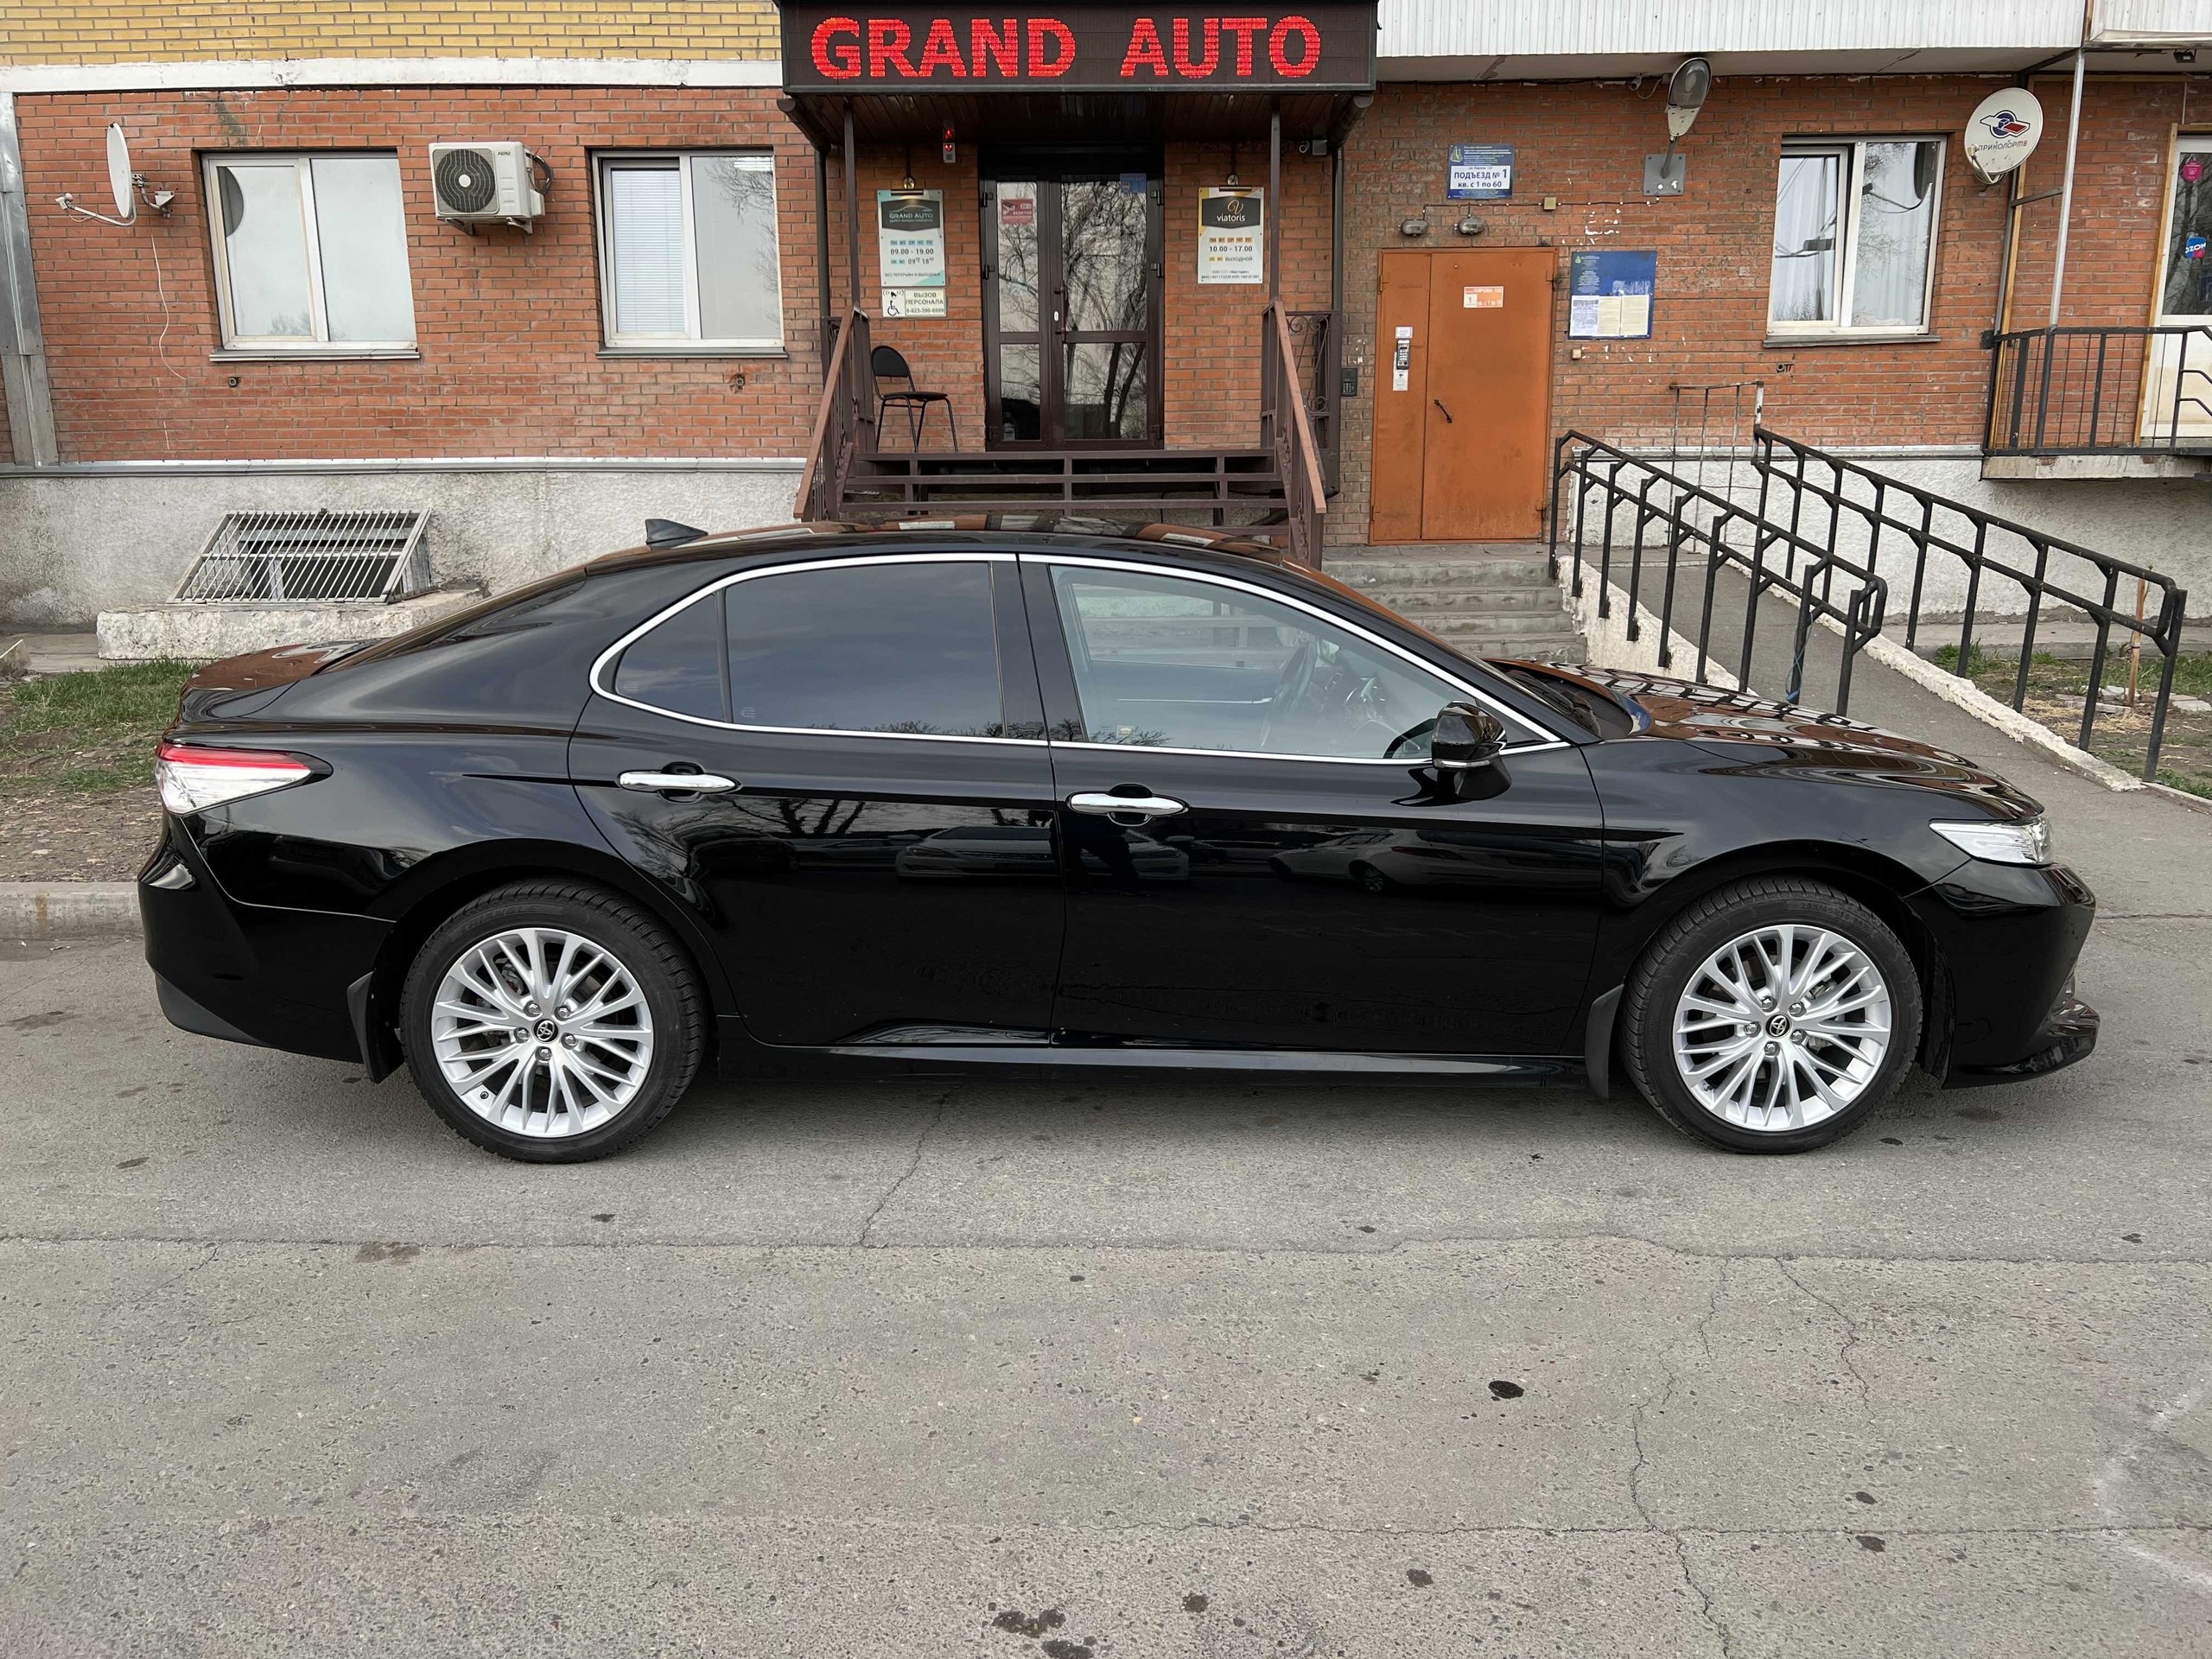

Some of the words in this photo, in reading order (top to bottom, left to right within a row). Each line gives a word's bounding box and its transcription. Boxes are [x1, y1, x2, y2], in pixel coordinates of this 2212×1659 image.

[810, 16, 1076, 79] GRAND
[1120, 16, 1321, 78] AUTO
[1503, 168, 1507, 178] 1
[1217, 213, 1246, 222] viatoris
